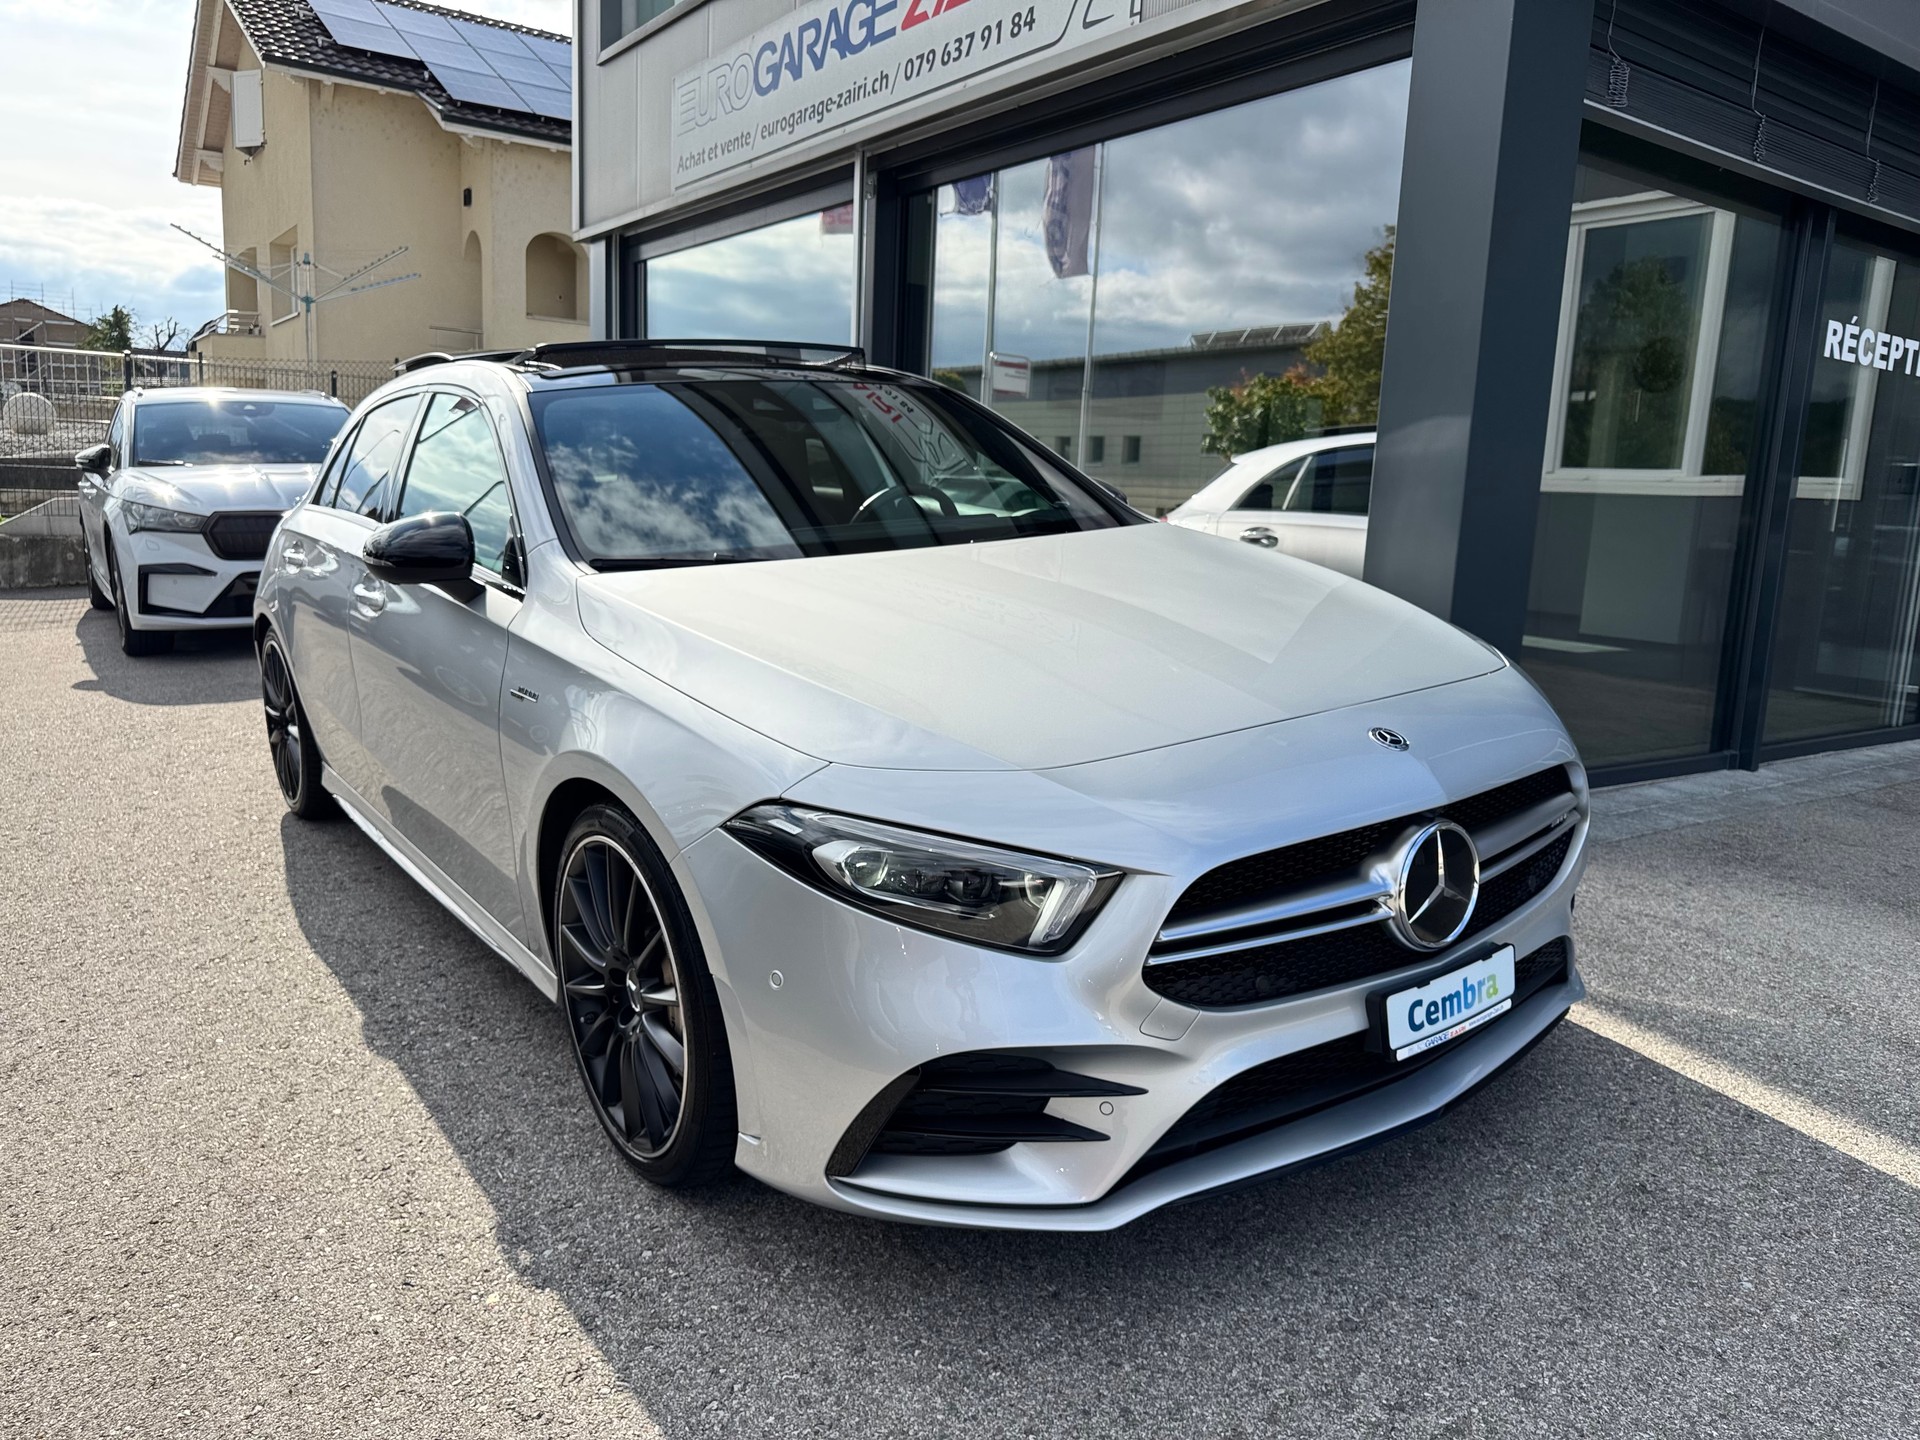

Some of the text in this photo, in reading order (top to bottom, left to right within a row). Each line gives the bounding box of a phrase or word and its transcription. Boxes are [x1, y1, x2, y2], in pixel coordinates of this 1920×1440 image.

[677, 5, 1036, 174] Achat et vente / eurogarage-zairi.ch / 079 637 91 84
[1408, 973, 1499, 1032] Cembra
